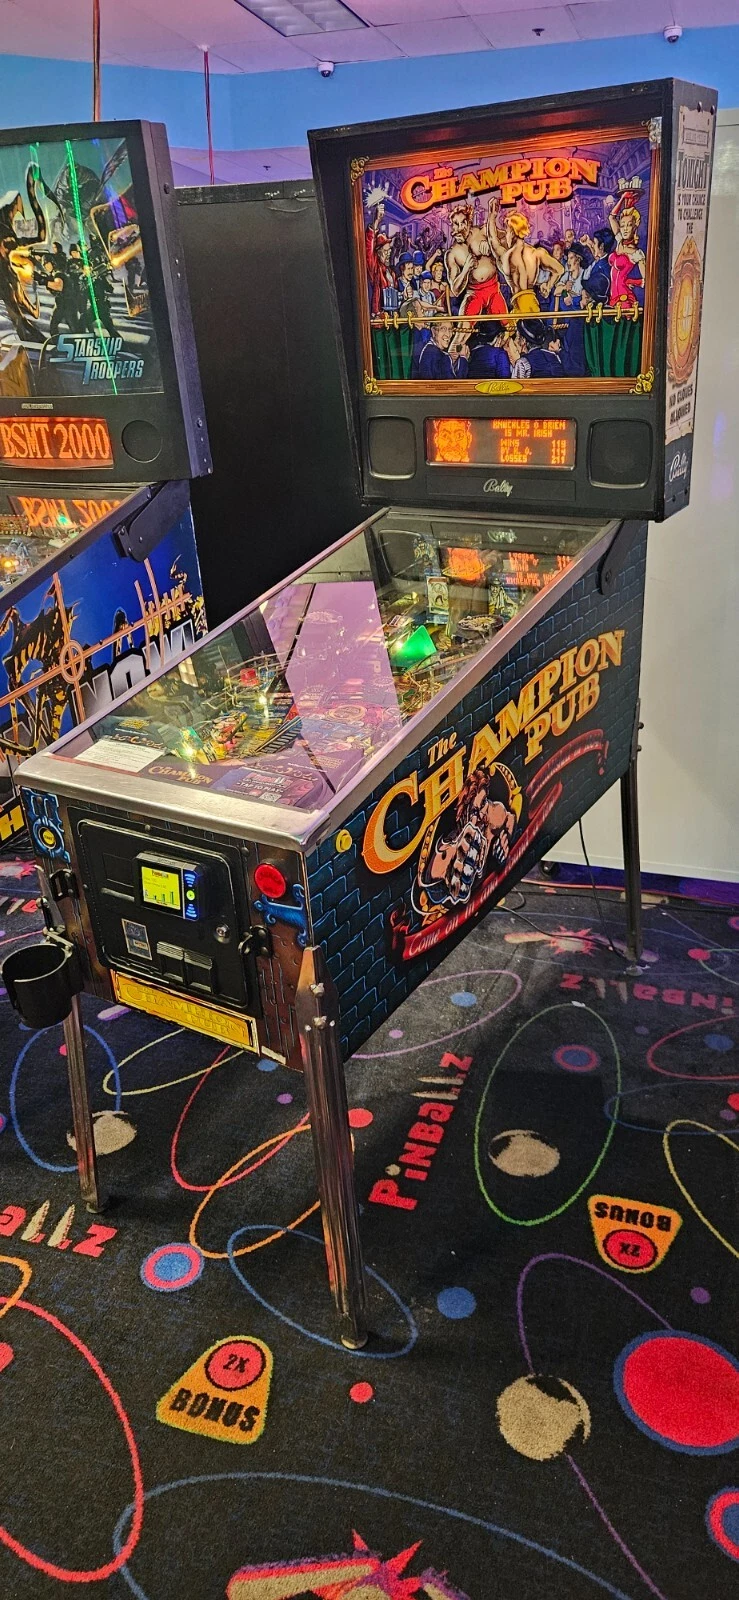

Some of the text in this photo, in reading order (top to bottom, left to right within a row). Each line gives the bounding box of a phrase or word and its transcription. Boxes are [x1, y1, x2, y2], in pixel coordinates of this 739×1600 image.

[400, 157, 600, 211] CHAMPION
[677, 151, 710, 189] TONIGHT
[500, 177, 573, 207] PUB
[683, 208, 703, 221] CHALLENGE
[686, 222, 694, 234] THE
[50, 333, 124, 363] STARSHIP
[74, 356, 146, 386] TROOPERS
[669, 394, 675, 407] NO
[492, 419, 530, 429] KNUCKLES
[543, 420, 566, 430] BRIEN
[516, 429, 530, 438] MR.
[533, 430, 553, 438] IRISH
[0, 423, 110, 459] BSMT 2000
[500, 438, 520, 447] WINS
[501, 455, 528, 463] LOSSES
[483, 479, 513, 497] Bally
[523, 673, 601, 764] PUB
[362, 631, 624, 874] CHAMPION
[427, 731, 456, 767] The
[409, 930, 439, 956] Come
[445, 915, 458, 935] on
[594, 1202, 672, 1232] BONUS
[619, 1241, 641, 1257] 2X
[223, 1354, 250, 1373] 2X
[169, 1388, 260, 1432] BONUS
